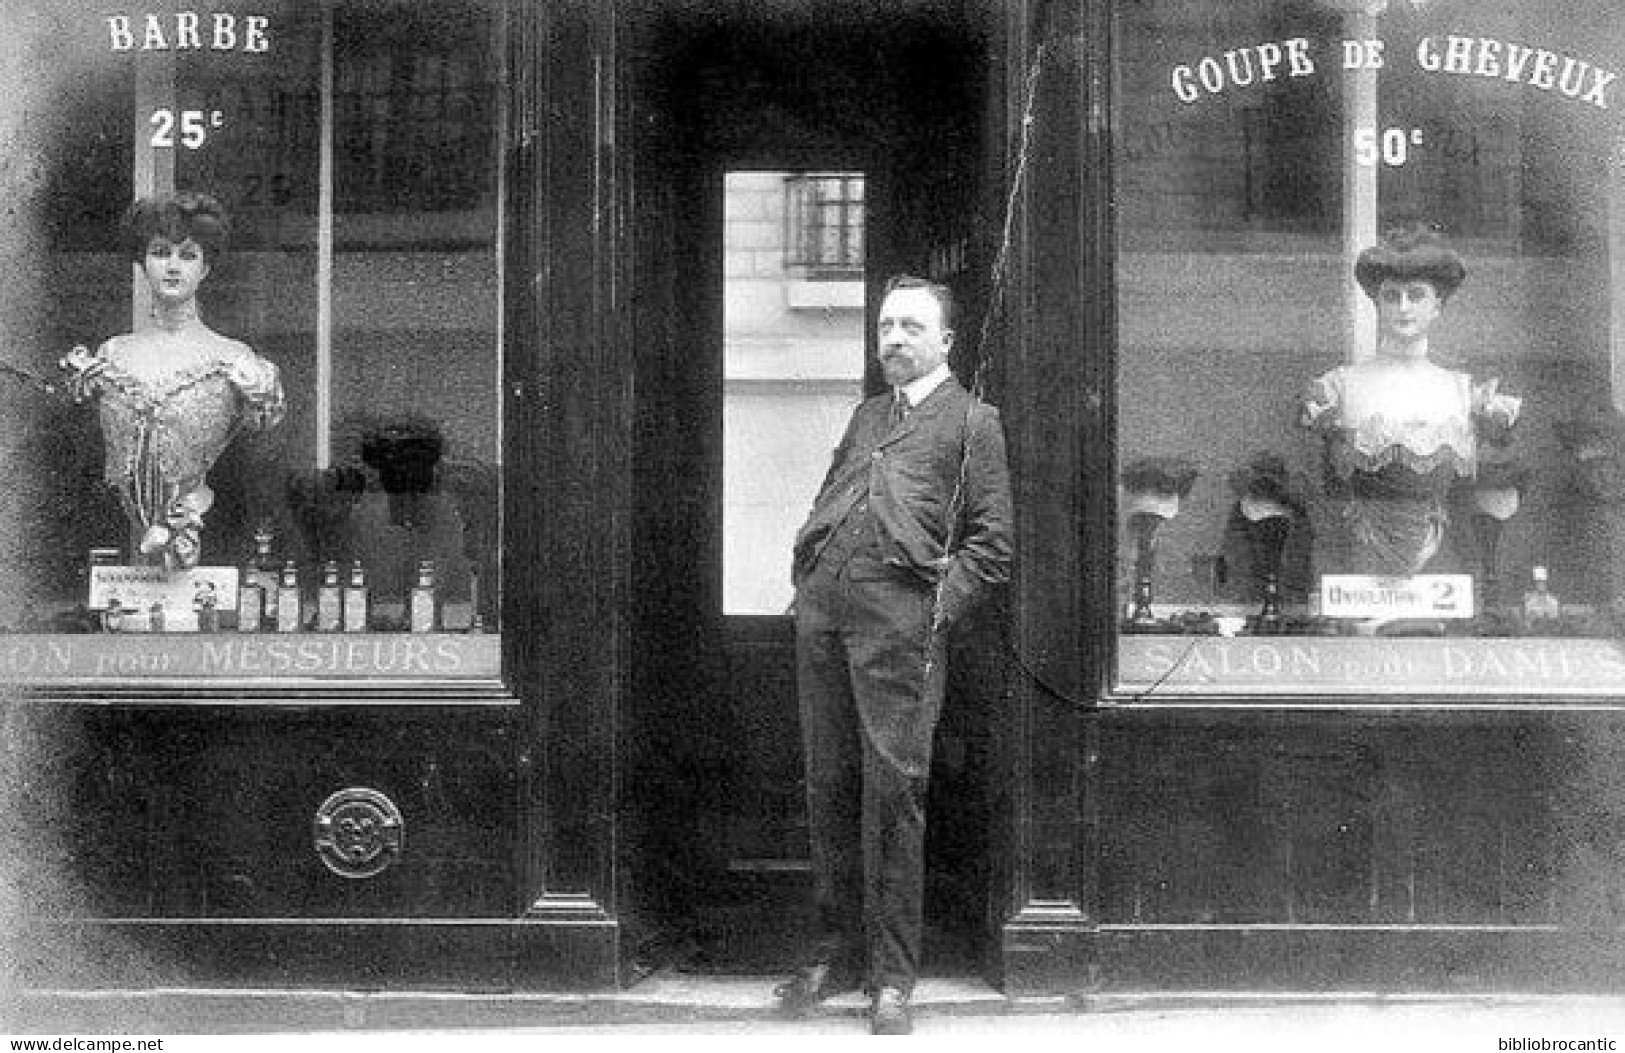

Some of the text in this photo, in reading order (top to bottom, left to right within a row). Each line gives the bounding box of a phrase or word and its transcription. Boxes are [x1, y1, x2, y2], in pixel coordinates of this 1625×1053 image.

[107, 11, 270, 52] BARBE
[1172, 36, 1616, 109] COUPE DE CHEVEUX
[1431, 581, 1456, 610] 2
[202, 641, 462, 671] MESSIEURS
[1144, 644, 1321, 677] SALON
